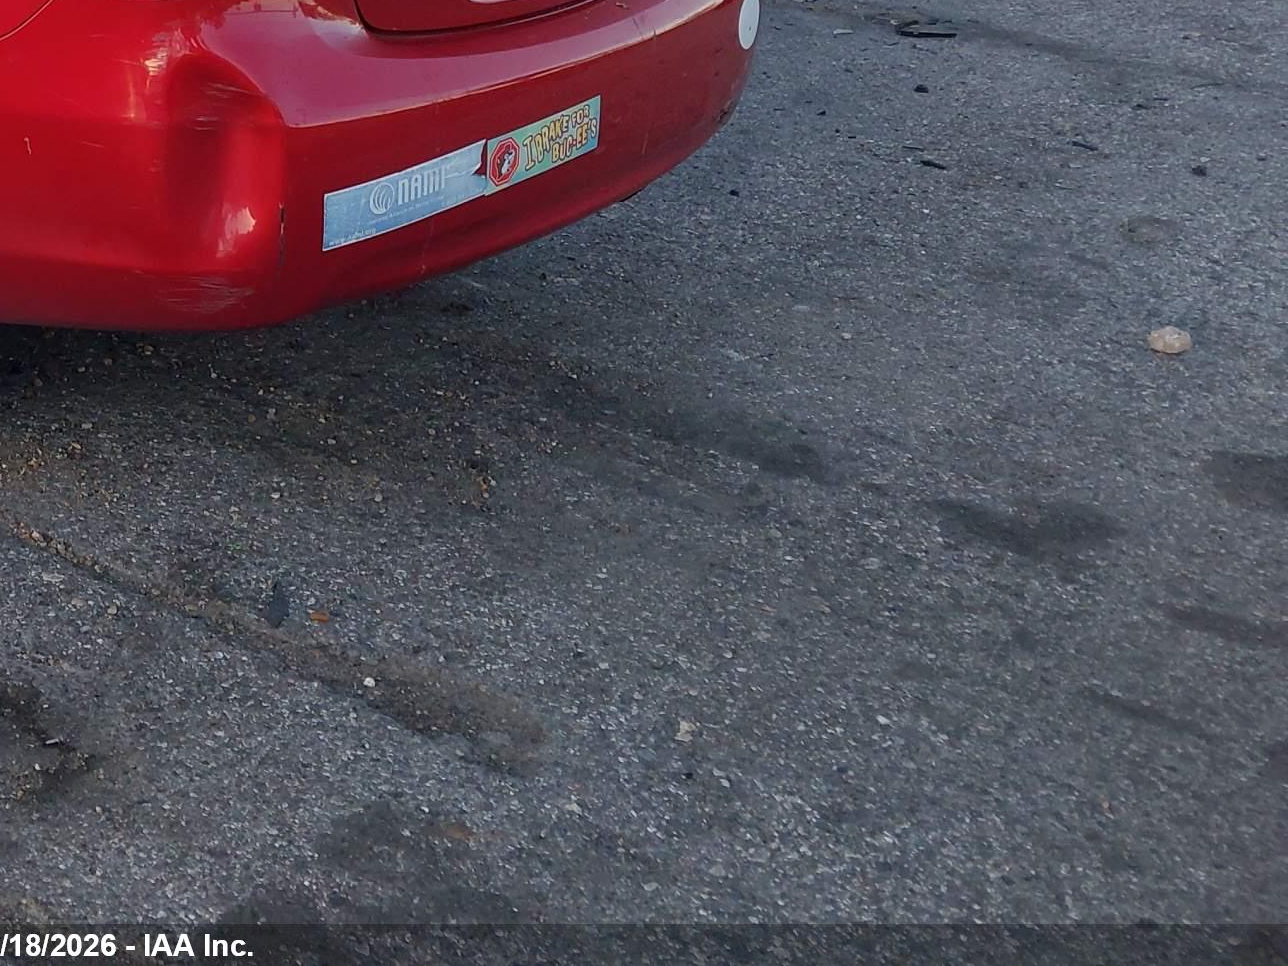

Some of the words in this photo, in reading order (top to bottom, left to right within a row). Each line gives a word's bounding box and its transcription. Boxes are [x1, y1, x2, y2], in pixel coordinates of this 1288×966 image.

[522, 135, 536, 171] I
[534, 114, 570, 163] BRAKE
[571, 104, 590, 128] FOR
